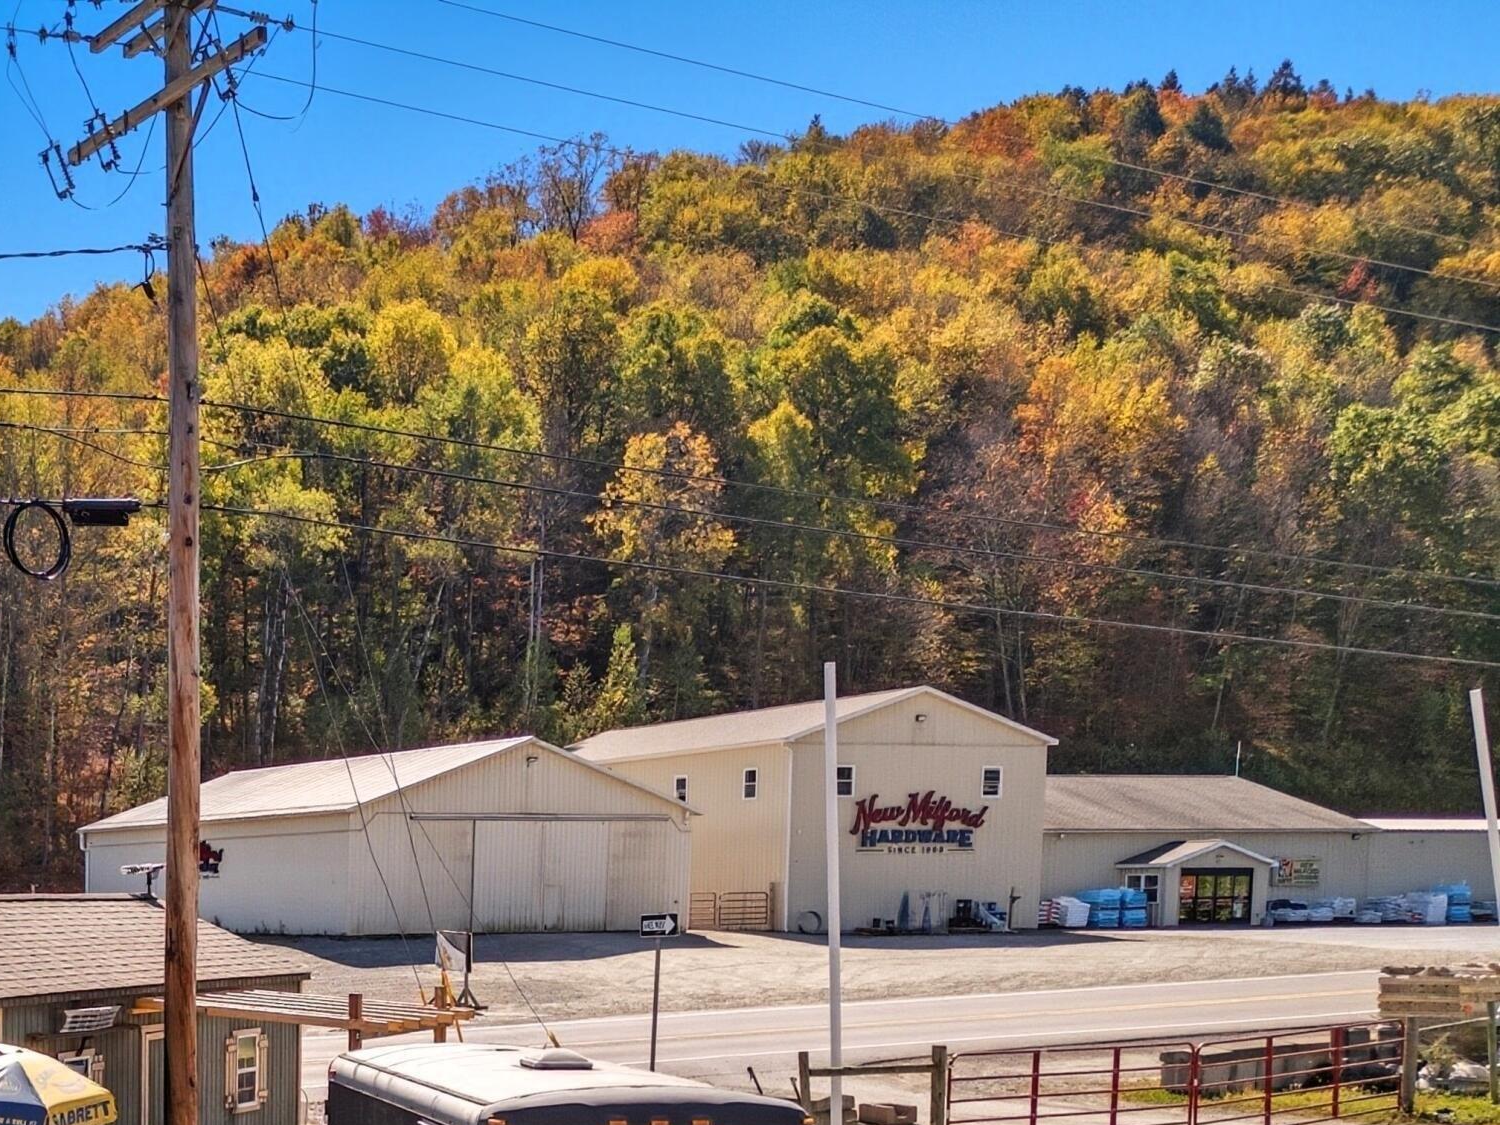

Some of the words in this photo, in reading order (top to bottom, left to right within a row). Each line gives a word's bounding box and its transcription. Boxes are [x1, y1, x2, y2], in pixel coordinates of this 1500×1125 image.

[849, 794, 905, 835] New
[898, 790, 989, 832] Milford
[861, 829, 974, 848] HARDWARE
[887, 846, 917, 854] SINCE
